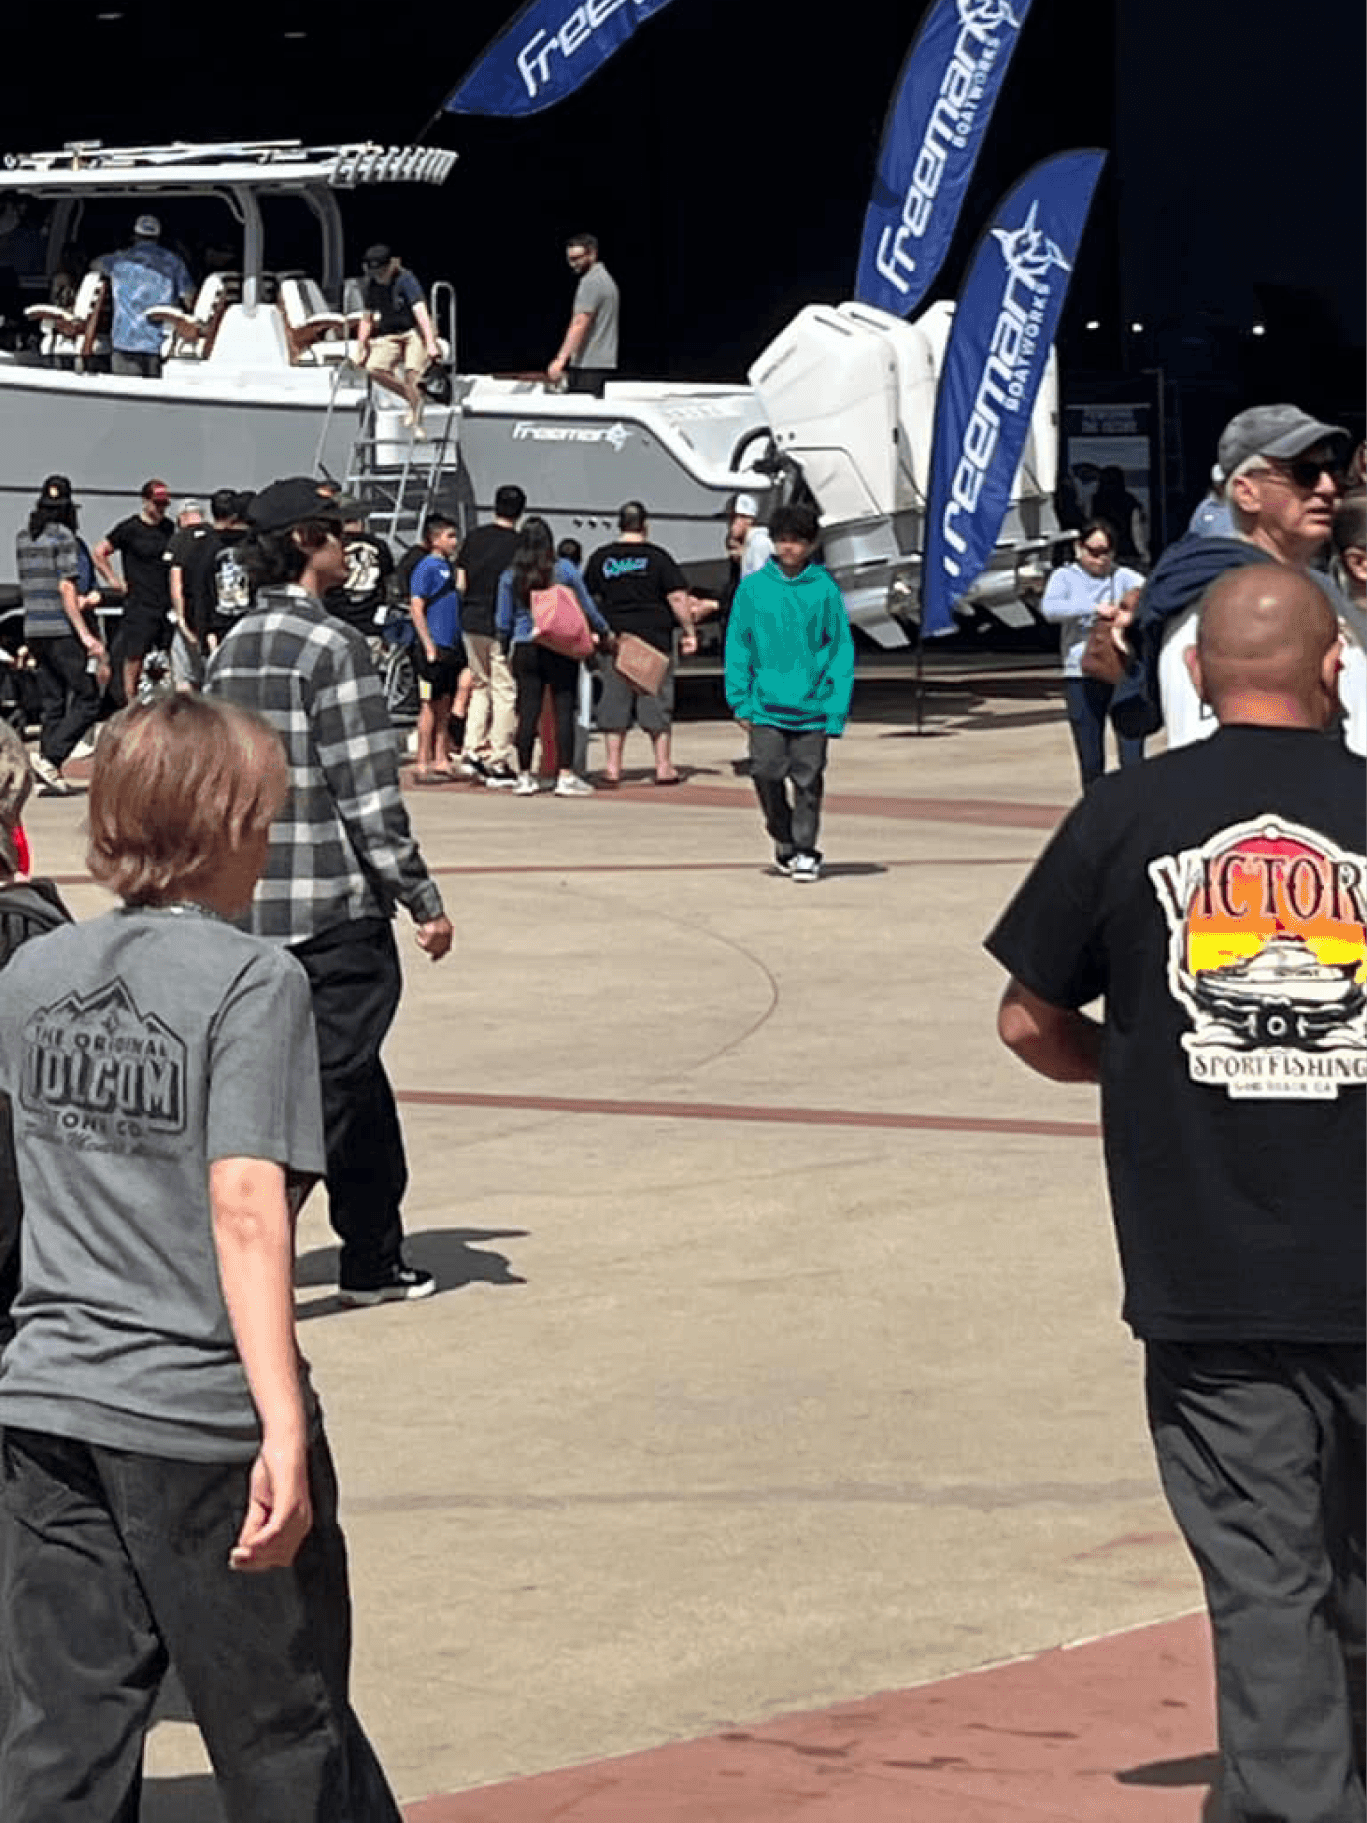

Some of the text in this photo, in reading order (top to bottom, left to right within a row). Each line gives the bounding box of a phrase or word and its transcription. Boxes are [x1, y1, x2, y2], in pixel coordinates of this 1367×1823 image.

[952, 37, 1000, 147] BOATWORKS
[1002, 283, 1051, 411] BOATWORKS
[1193, 1054, 1367, 1077] SPORTFISHING
